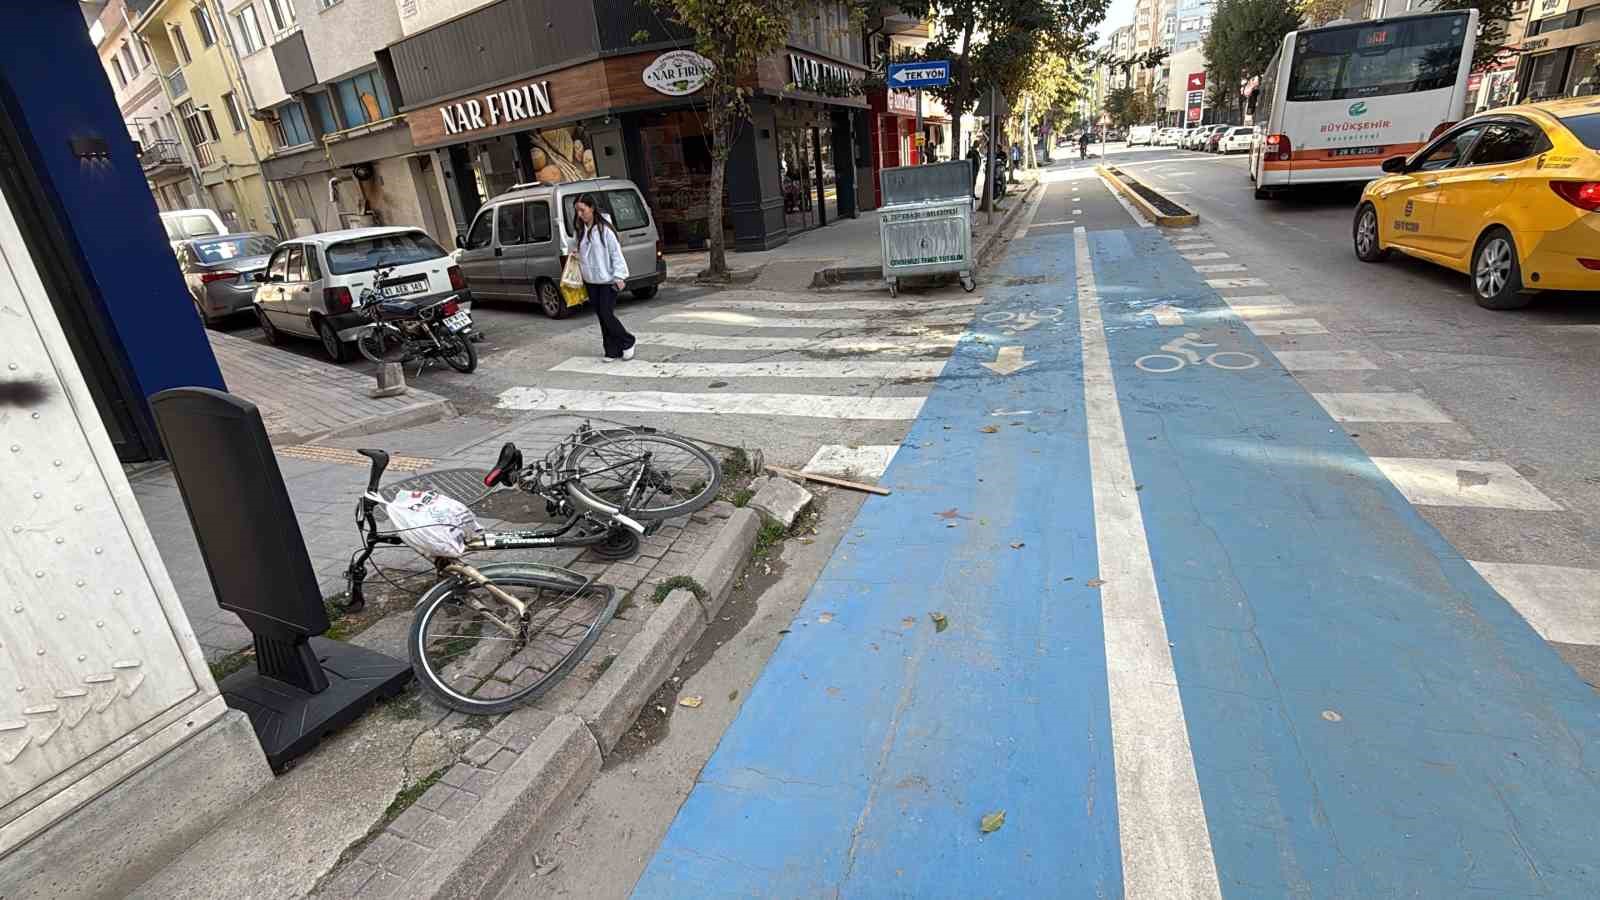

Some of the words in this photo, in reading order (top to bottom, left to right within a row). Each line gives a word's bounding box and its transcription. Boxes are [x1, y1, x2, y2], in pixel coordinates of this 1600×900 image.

[652, 68, 675, 81] NAR
[904, 71, 923, 80] TEK
[440, 99, 486, 136] NAR
[485, 80, 553, 126] FIRIN
